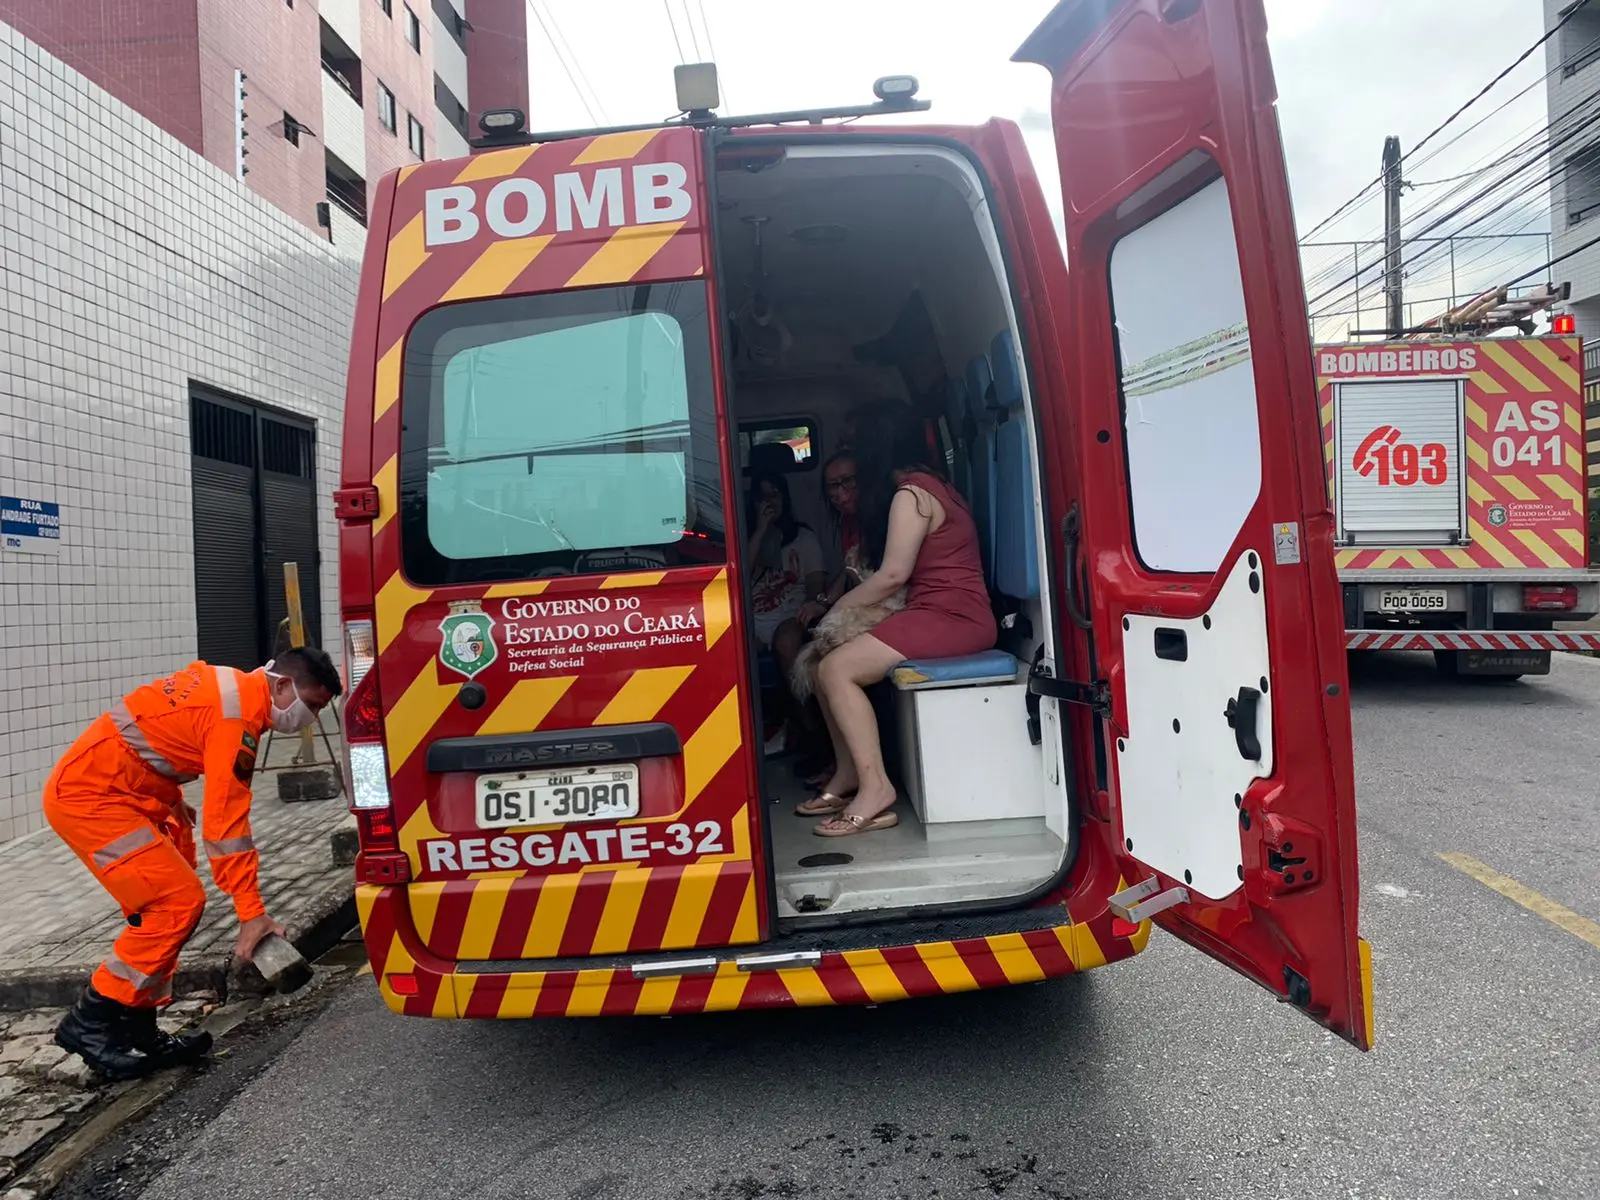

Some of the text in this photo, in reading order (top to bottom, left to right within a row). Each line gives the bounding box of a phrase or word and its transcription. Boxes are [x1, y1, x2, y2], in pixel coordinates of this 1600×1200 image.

[425, 161, 693, 246] BOMB
[1320, 348, 1477, 374] BOMBEIROS
[1494, 399, 1561, 432] AS
[1370, 442, 1448, 486] 193
[1491, 434, 1561, 467] 041
[20, 499, 42, 511] RUA
[502, 596, 640, 620] GOVERNO DO
[503, 607, 701, 645] ESTADO DO CEARÁ
[507, 633, 703, 659] Secretaria da Segurança Pública e
[508, 656, 585, 673] Defesa Social
[485, 741, 615, 763] MASTER
[425, 820, 724, 873] RESGATE-32
